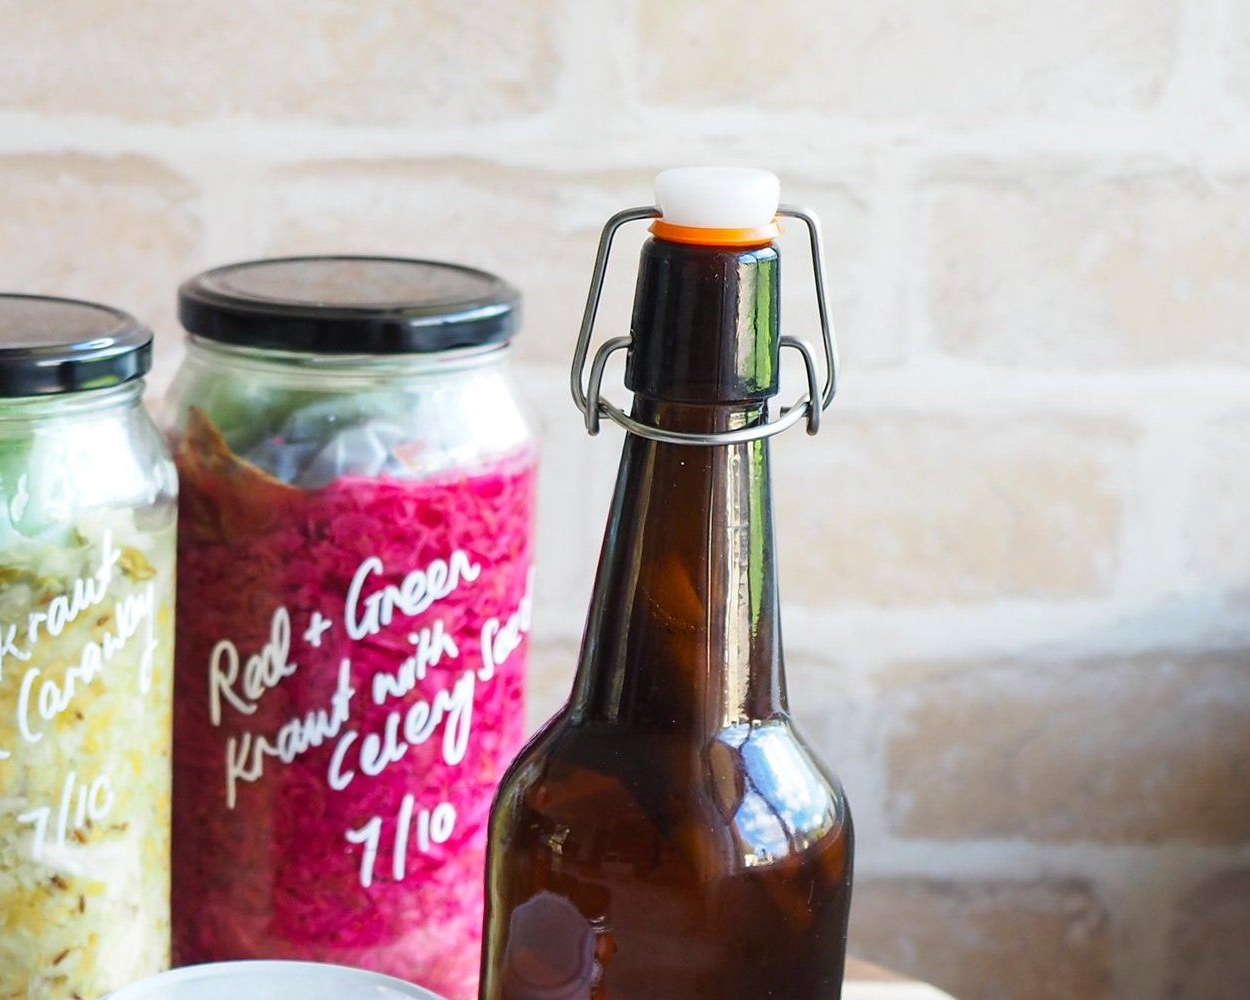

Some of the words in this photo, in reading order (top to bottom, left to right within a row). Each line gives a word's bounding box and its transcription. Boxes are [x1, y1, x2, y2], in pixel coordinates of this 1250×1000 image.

[209, 606, 297, 726] Red
[345, 550, 481, 640] Green
[227, 658, 355, 809] Kraut
[372, 619, 459, 705] with
[328, 669, 475, 791] Celery
[17, 771, 114, 858] 7/10
[345, 793, 456, 888] 7/10
